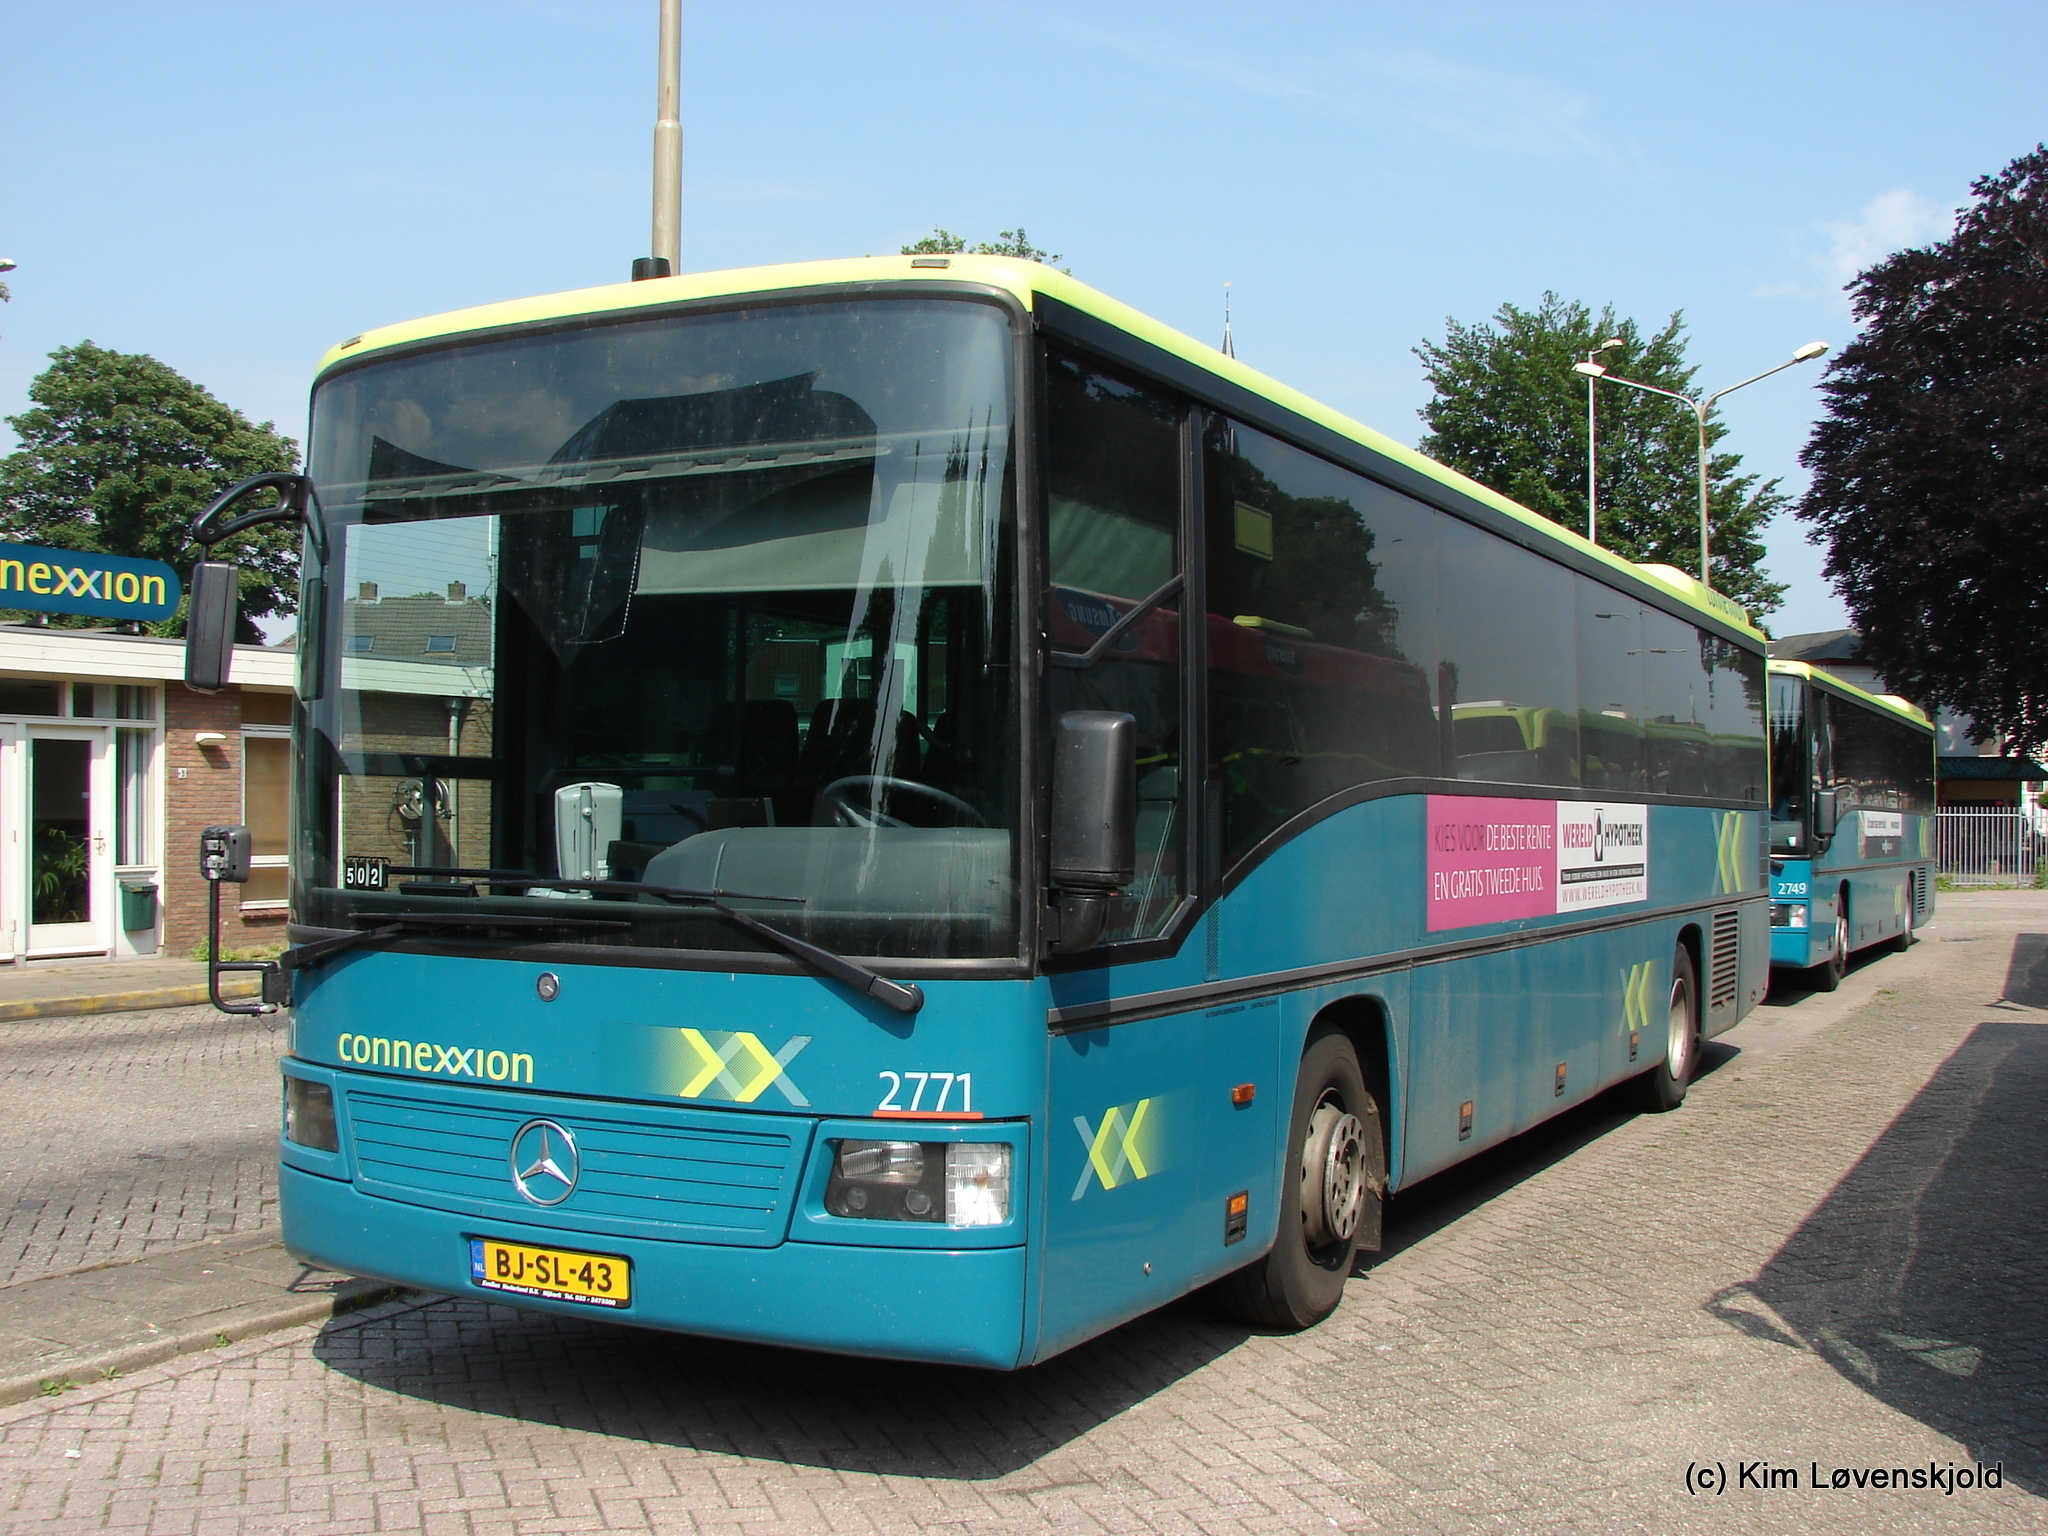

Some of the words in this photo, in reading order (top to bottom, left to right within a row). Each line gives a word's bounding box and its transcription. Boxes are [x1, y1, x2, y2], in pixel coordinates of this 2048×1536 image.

[1435, 824, 1456, 852] KIES
[1458, 824, 1485, 852] VOOR
[1486, 824, 1499, 851] DE
[1500, 824, 1525, 850] BESTE
[1526, 825, 1551, 850] RENTE
[1562, 823, 1593, 849] WERELD
[1604, 823, 1643, 847] HYPOTHEEK
[346, 867, 379, 885] 502
[1434, 871, 1449, 901] EN
[1450, 870, 1484, 899] GRATIS
[1484, 867, 1521, 896] TWEEDE
[1522, 866, 1544, 892] HUIS.
[1777, 882, 1806, 896] 2749
[1562, 881, 1643, 904] WWW.WERELDHYPOTHEEK.NL
[338, 1031, 535, 1085] connexxion
[878, 1071, 972, 1113] 2771
[474, 1262, 485, 1272] NL
[496, 1249, 613, 1293] BJ-SL-43
